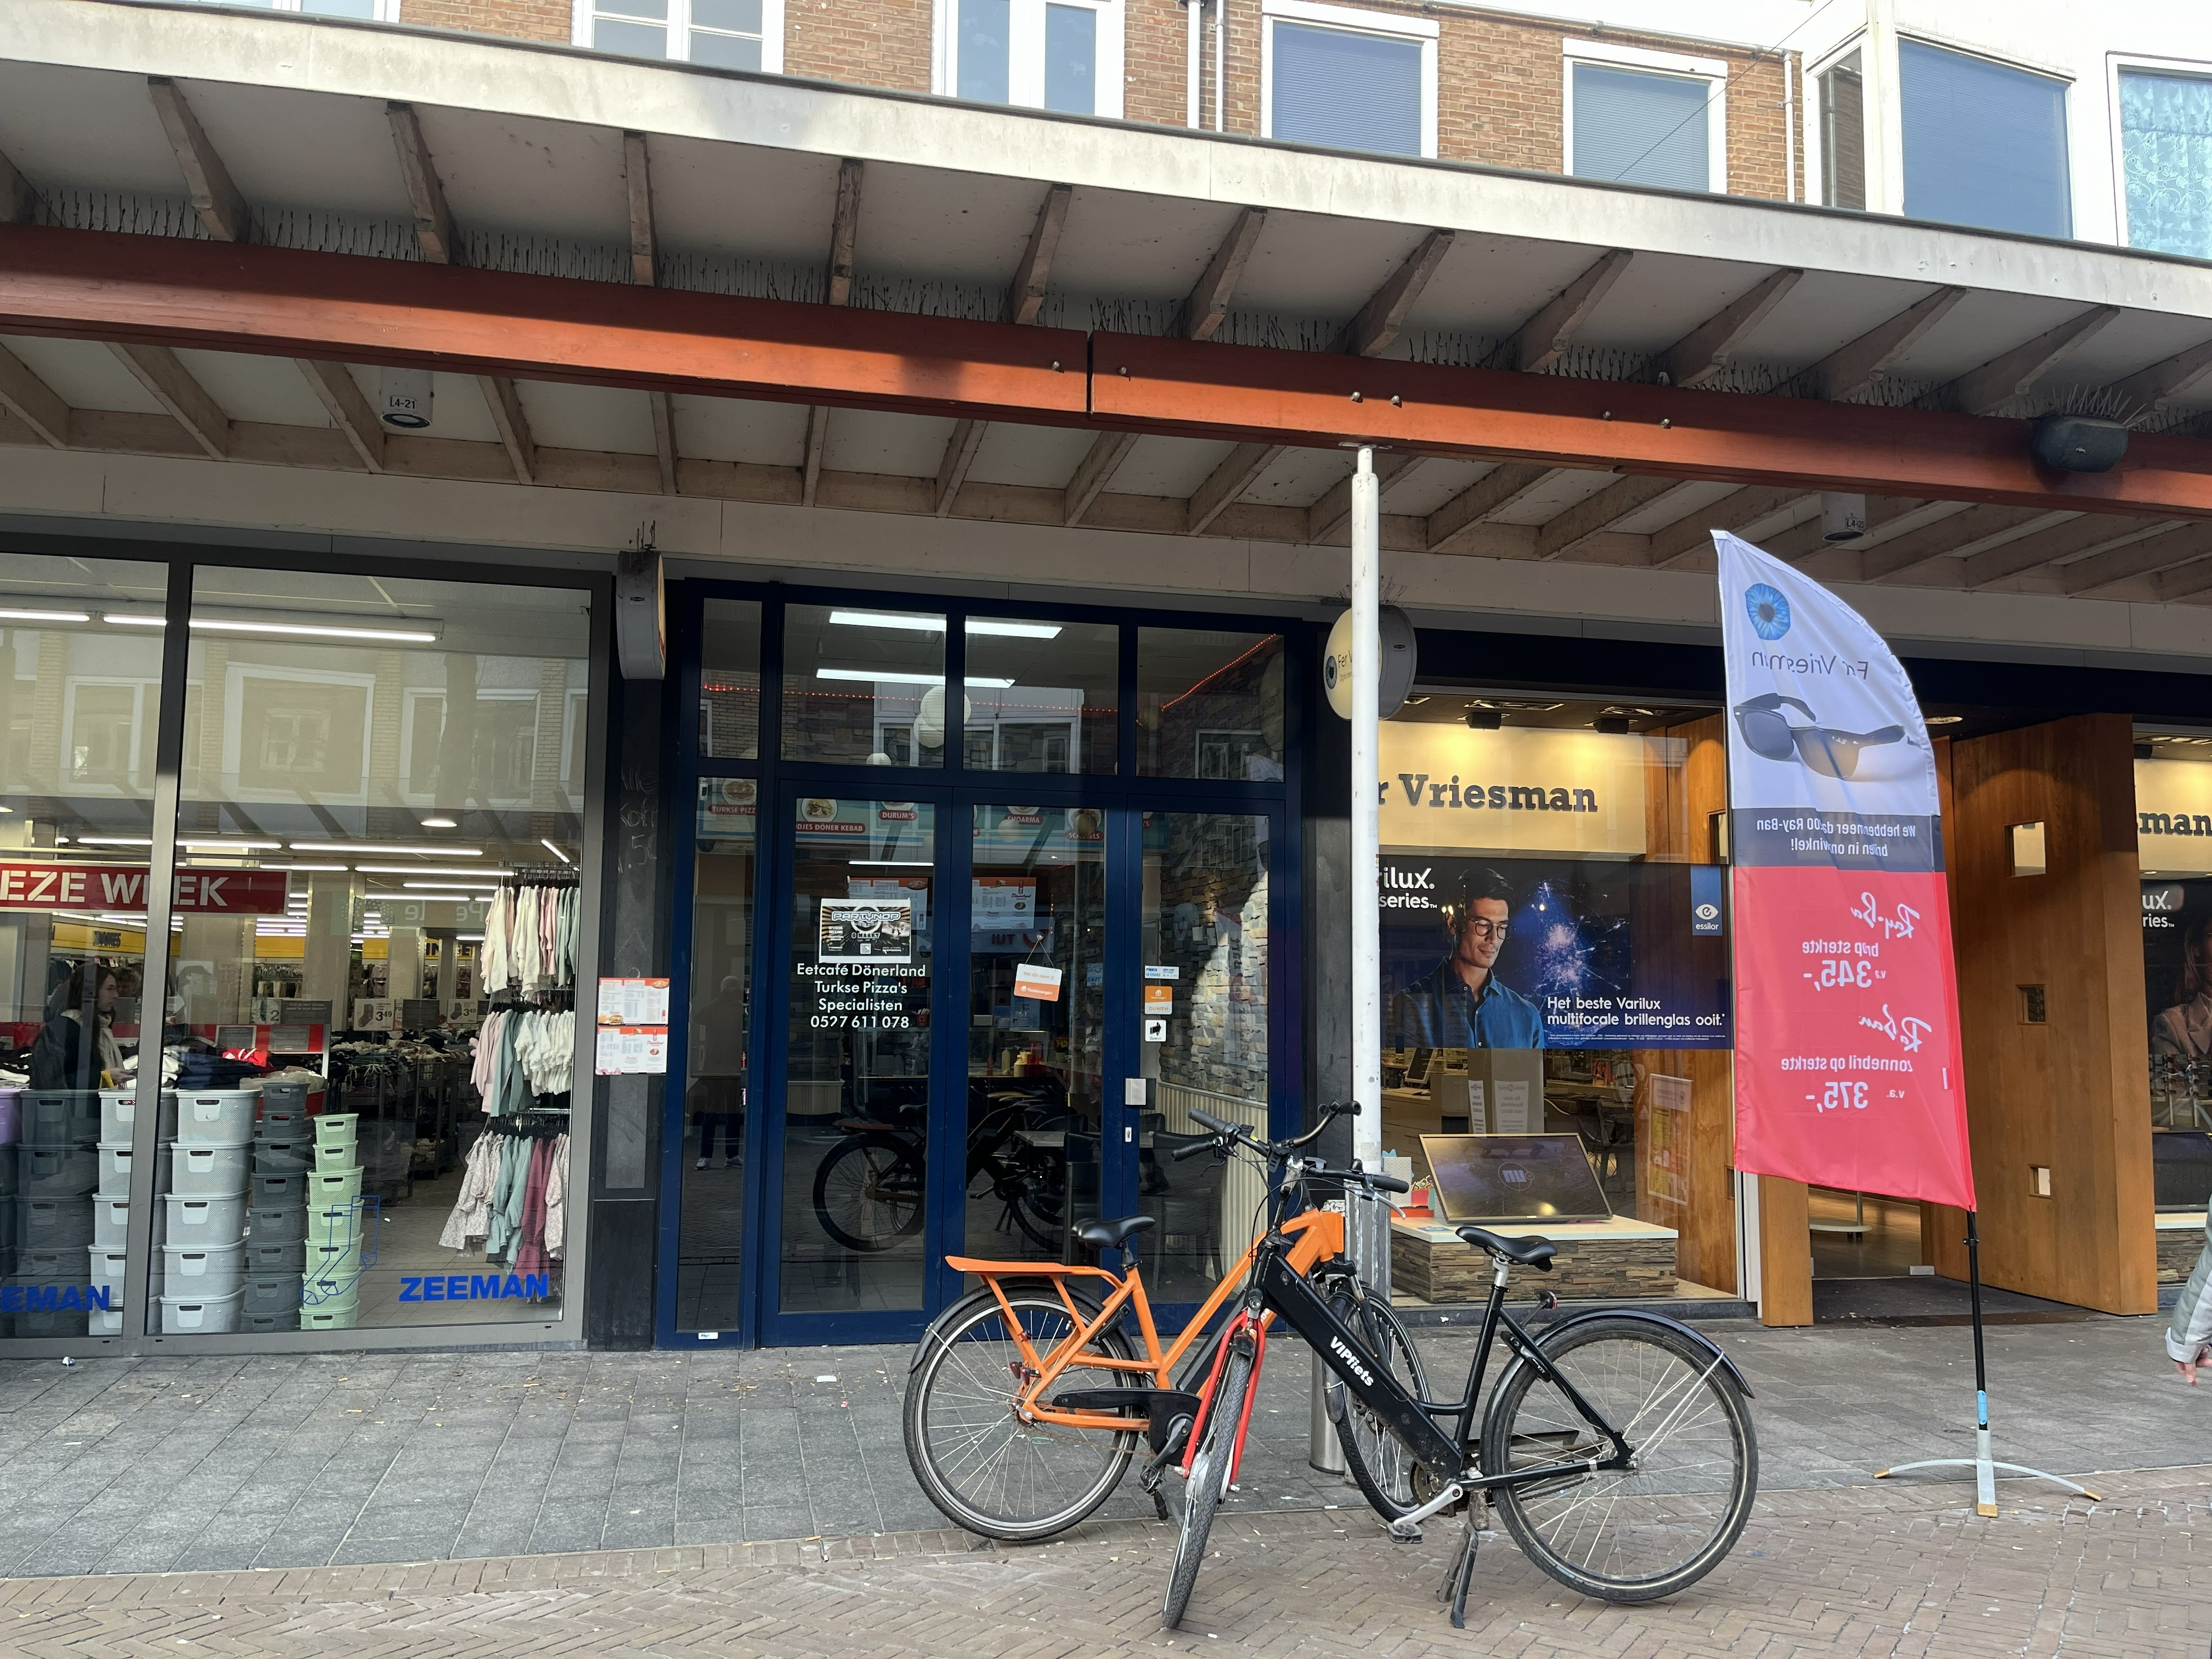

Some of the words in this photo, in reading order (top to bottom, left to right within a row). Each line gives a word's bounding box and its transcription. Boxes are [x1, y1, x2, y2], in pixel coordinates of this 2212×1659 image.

[390, 399, 416, 409] L4-21
[1397, 774, 1598, 812] Vriesman
[882, 811, 914, 820] DURUM'S
[815, 823, 838, 831] DÖNER
[100, 872, 230, 907] WEK
[832, 911, 901, 923] PARTYNOP
[1695, 922, 1719, 931] essilor
[797, 963, 848, 976] Eetcafé
[852, 964, 926, 977] Dönerland
[815, 980, 859, 994] Turkse
[863, 981, 907, 994] Pizza's
[819, 998, 902, 1013] Specialisten
[1548, 997, 1571, 1009] Het
[1576, 997, 1612, 1010] beste
[1617, 997, 1661, 1010] Varilux
[851, 1015, 876, 1028] 611
[882, 1016, 909, 1029] 078
[1548, 1013, 1620, 1026] multifocale
[1624, 1013, 1691, 1029] brillenglas
[398, 1273, 549, 1302] ZEEMAN
[1330, 1335, 1374, 1387] VIPfiets
